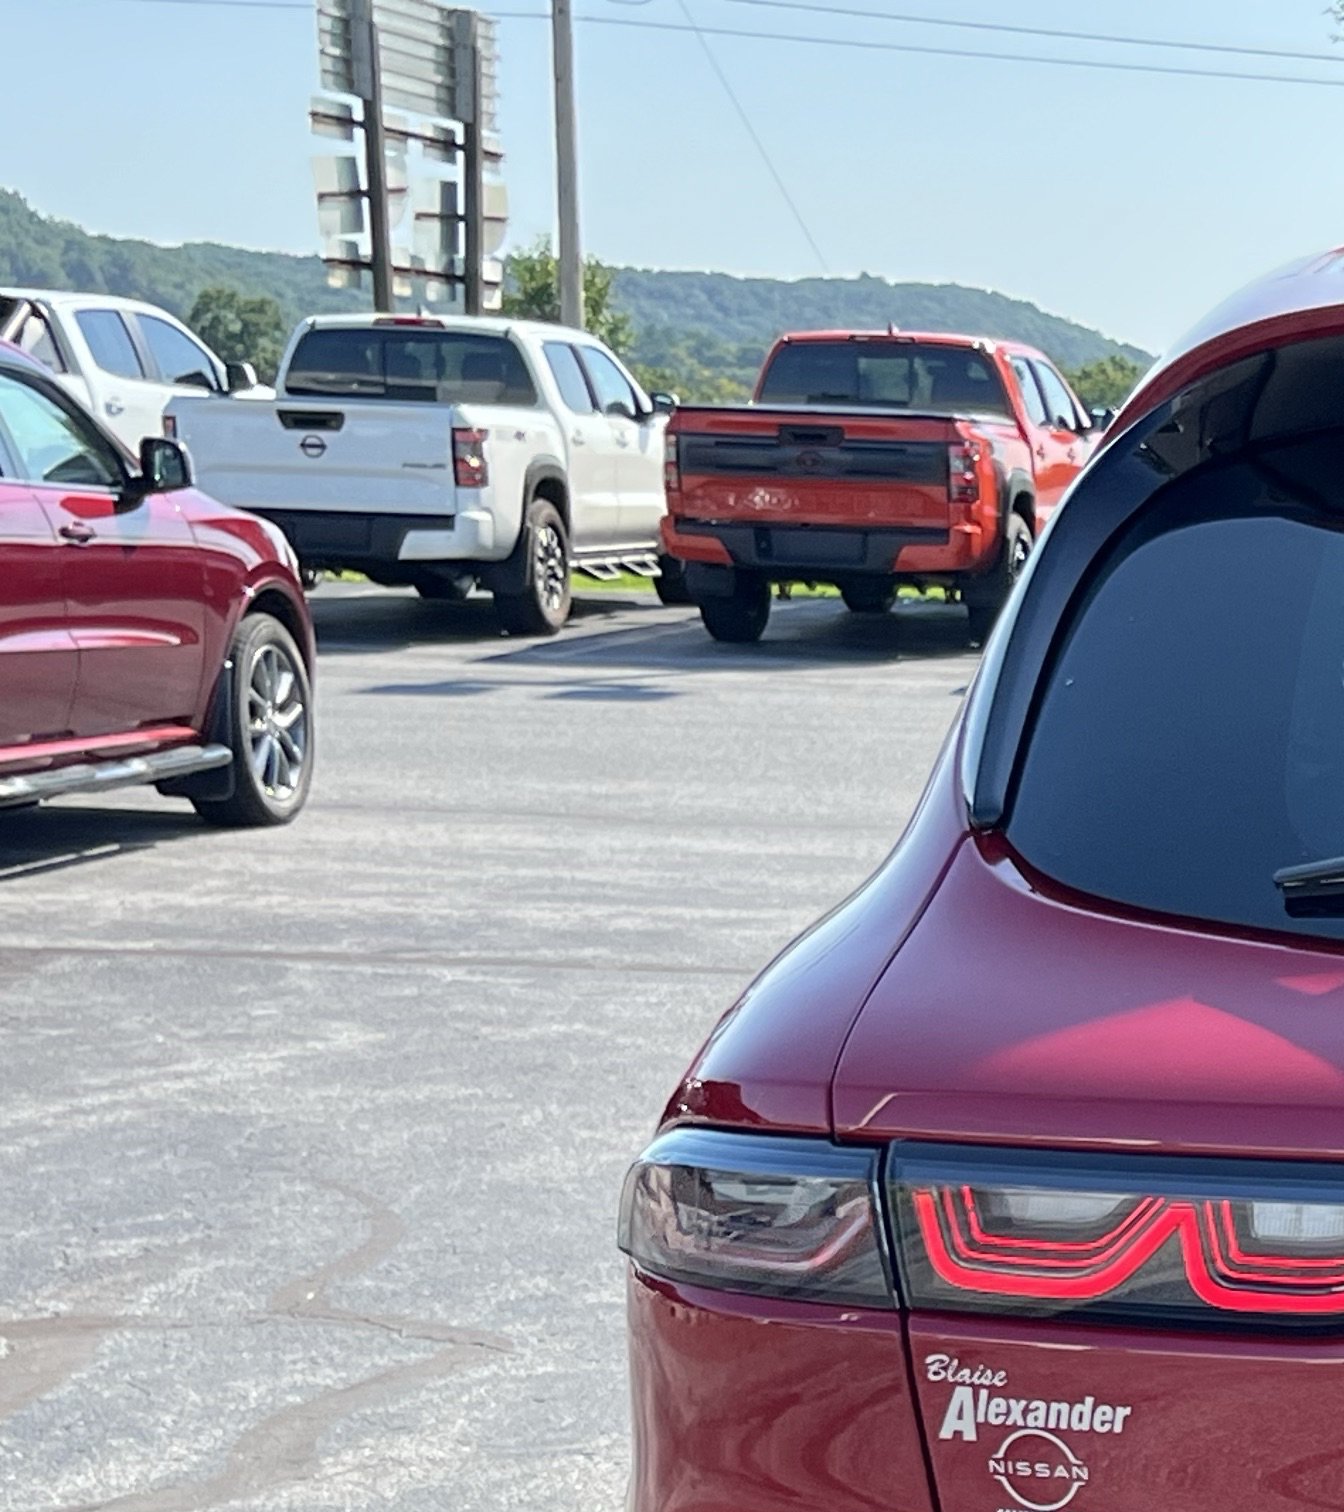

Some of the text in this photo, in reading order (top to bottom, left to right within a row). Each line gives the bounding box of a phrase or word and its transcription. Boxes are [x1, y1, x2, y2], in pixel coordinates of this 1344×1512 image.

[925, 1353, 1008, 1387] Blaise
[938, 1385, 1132, 1442] Alexander
[988, 1459, 1089, 1481] NISSAN
